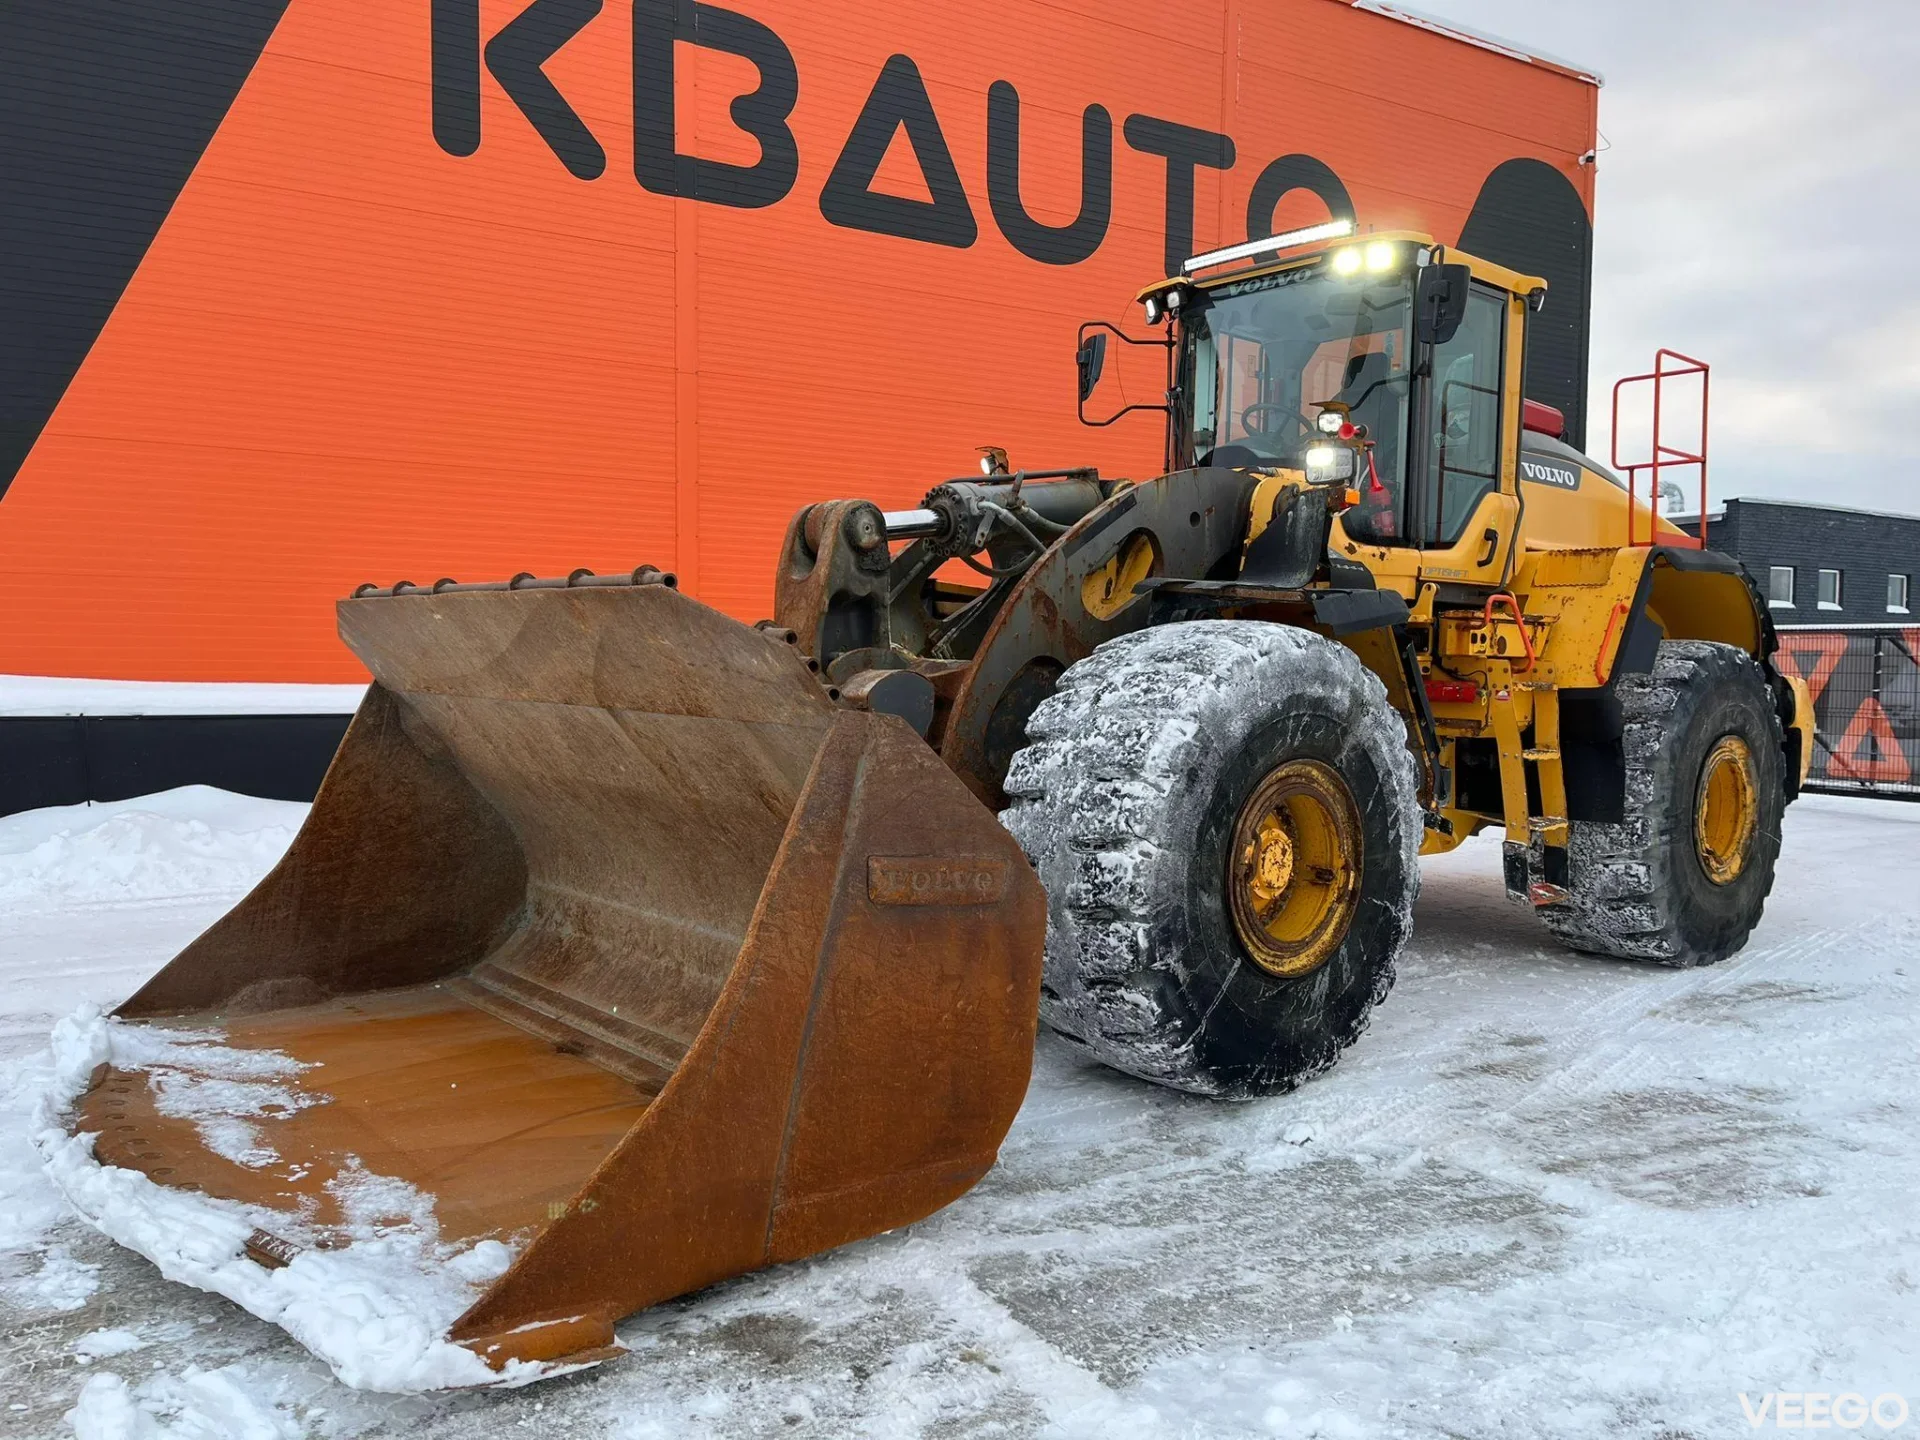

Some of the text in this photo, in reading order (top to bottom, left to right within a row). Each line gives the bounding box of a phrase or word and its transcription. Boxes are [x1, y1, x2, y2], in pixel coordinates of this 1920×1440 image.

[431, 0, 1355, 277] KBAUTO
[1229, 268, 1312, 296] VOLVO
[1521, 462, 1575, 486] VOLVO
